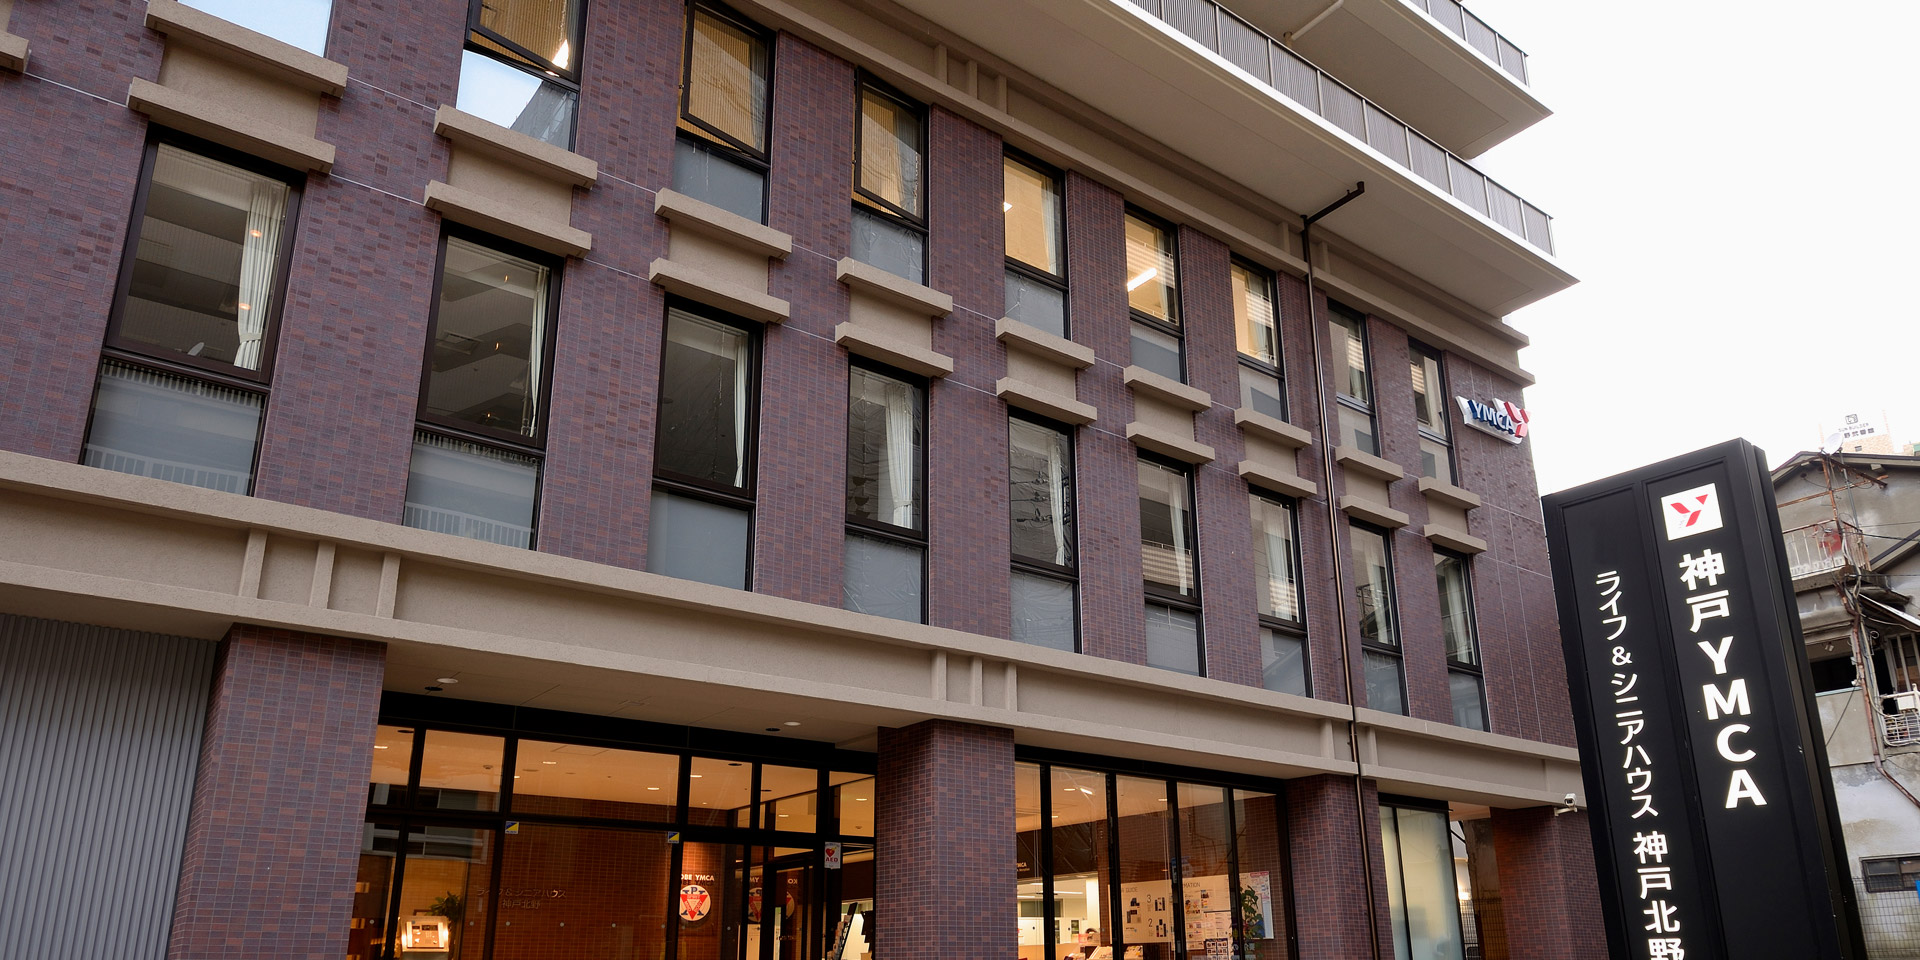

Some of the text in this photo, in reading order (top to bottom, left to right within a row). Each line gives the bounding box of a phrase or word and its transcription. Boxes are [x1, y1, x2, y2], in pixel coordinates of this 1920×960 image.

[1467, 399, 1516, 434] YMCA
[1679, 548, 1768, 809] 神戸YMCA
[680, 873, 715, 882] OBE YMCA
[1146, 893, 1152, 904] 3
[1147, 918, 1153, 928] 2
